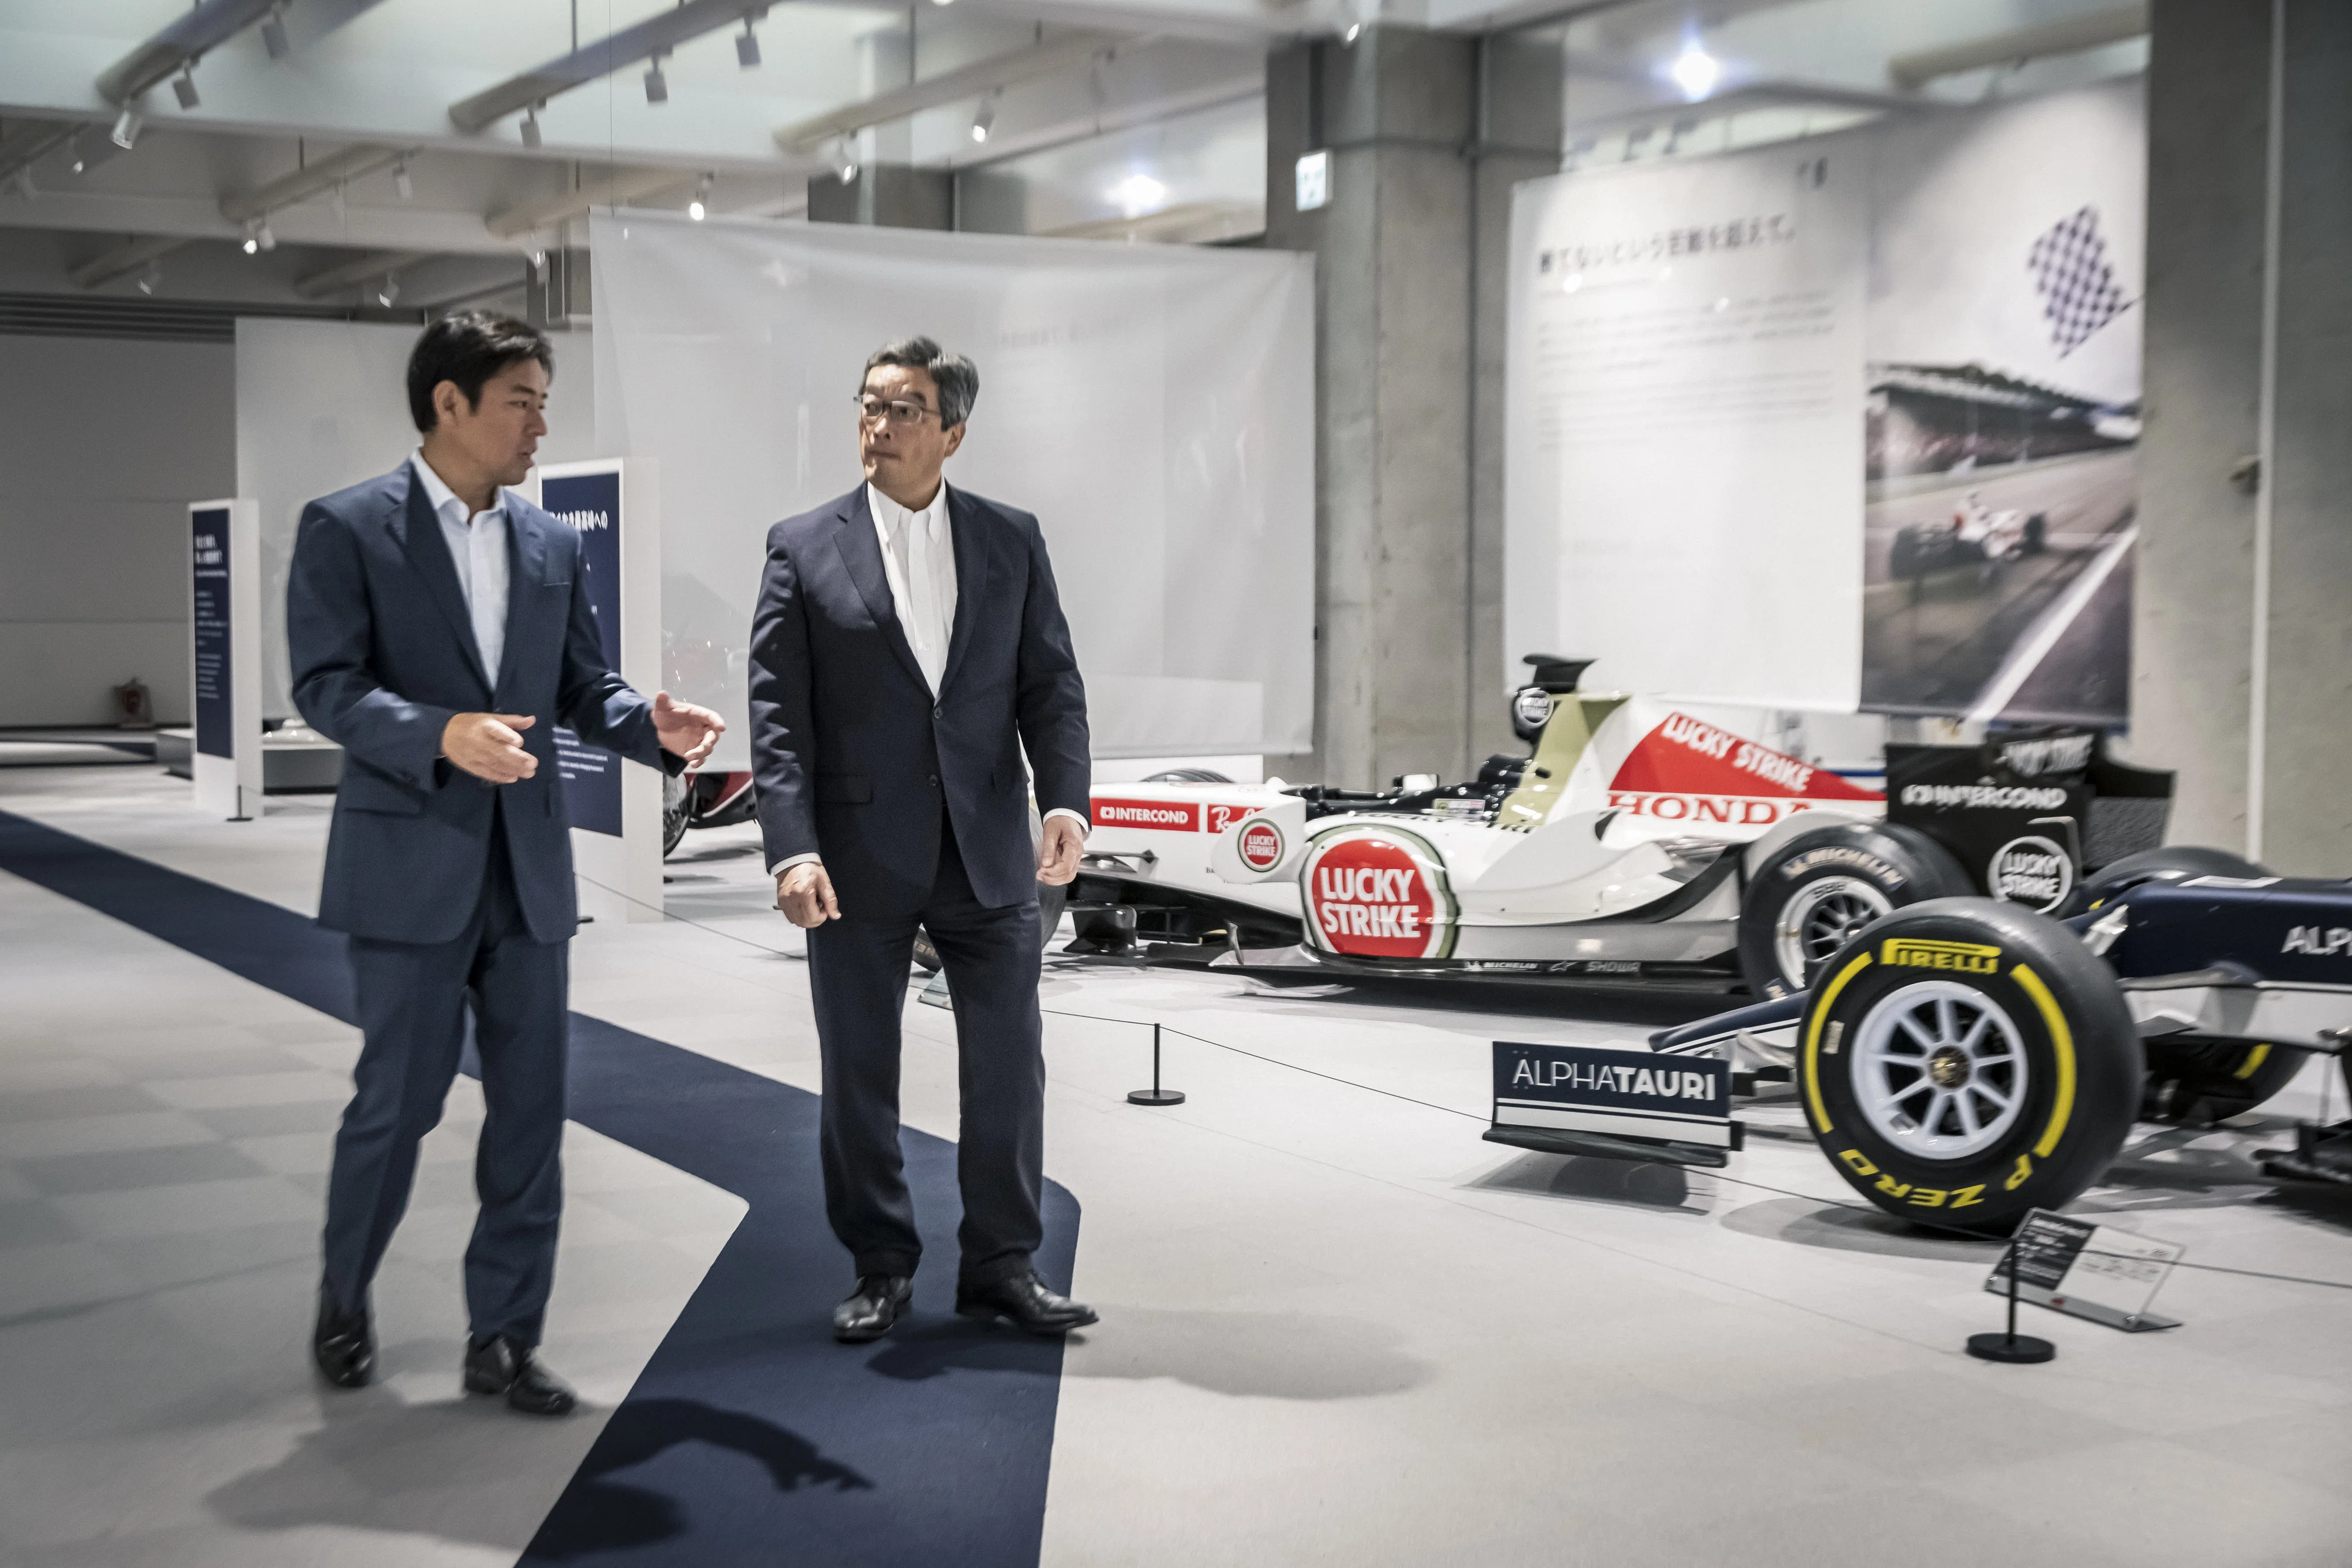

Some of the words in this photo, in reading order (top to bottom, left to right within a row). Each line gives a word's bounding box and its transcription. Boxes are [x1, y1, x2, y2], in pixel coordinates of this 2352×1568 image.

[1662, 714, 1738, 759] LUCKY
[1732, 743, 1814, 792] STRIKE
[1116, 807, 1188, 824] INTERCOND
[1247, 834, 1275, 845] LUCKY
[1247, 846, 1275, 857] STRIKE
[2000, 852, 2061, 875] LUCKY
[1320, 867, 1415, 902] LUCKY
[1997, 874, 2060, 900] STRIKE
[1322, 901, 1421, 938] STRIKE
[1880, 938, 2002, 974] PIRELLI
[1512, 1058, 1716, 1101] ALPHATAURI
[1838, 1148, 1987, 1209] ZERO
